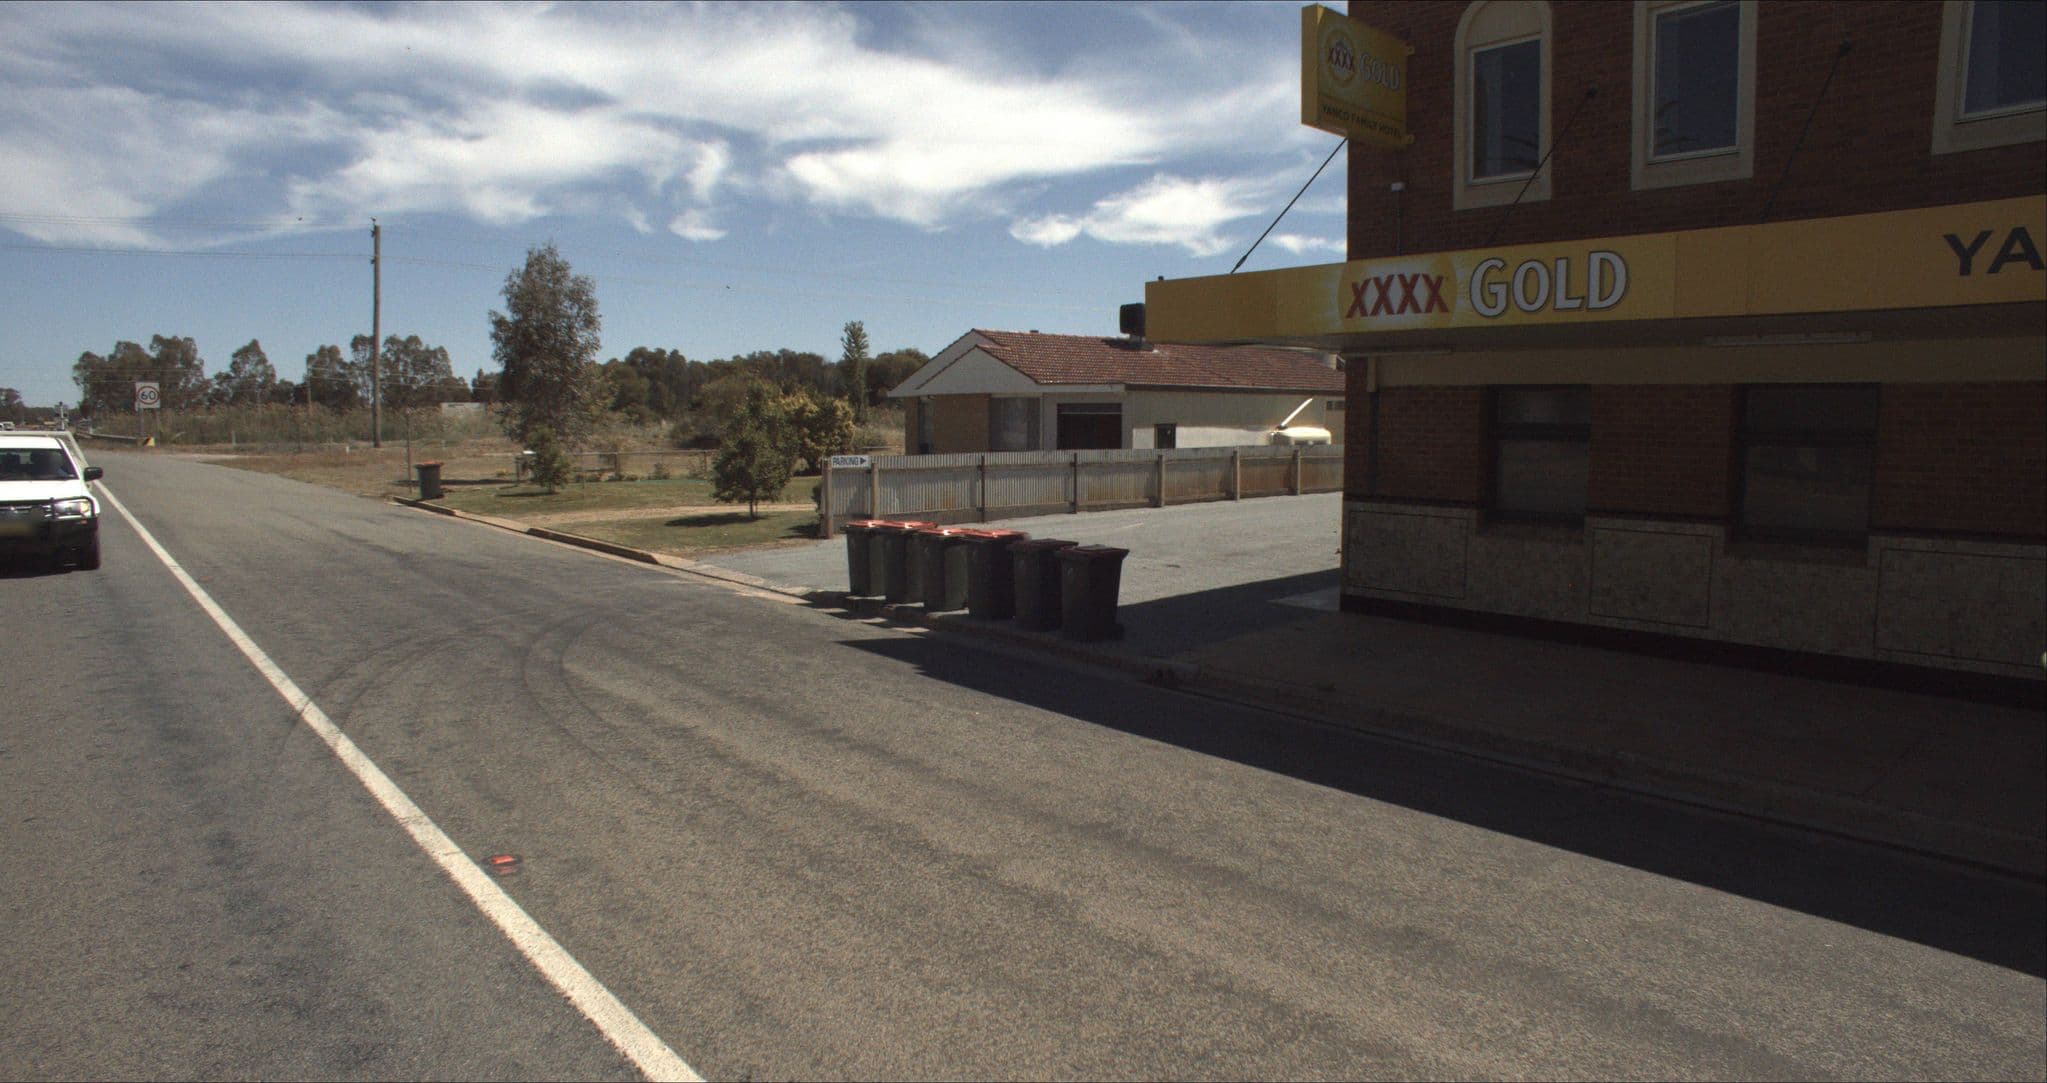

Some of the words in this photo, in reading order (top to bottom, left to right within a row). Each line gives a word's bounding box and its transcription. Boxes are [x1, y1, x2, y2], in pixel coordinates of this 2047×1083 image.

[1359, 52, 1400, 91] GOLD
[1943, 226, 2046, 276] YA
[1345, 273, 1449, 319] XXXX
[1469, 250, 1628, 318] GOLD
[141, 390, 156, 400] 60
[832, 456, 859, 466] PARKING
